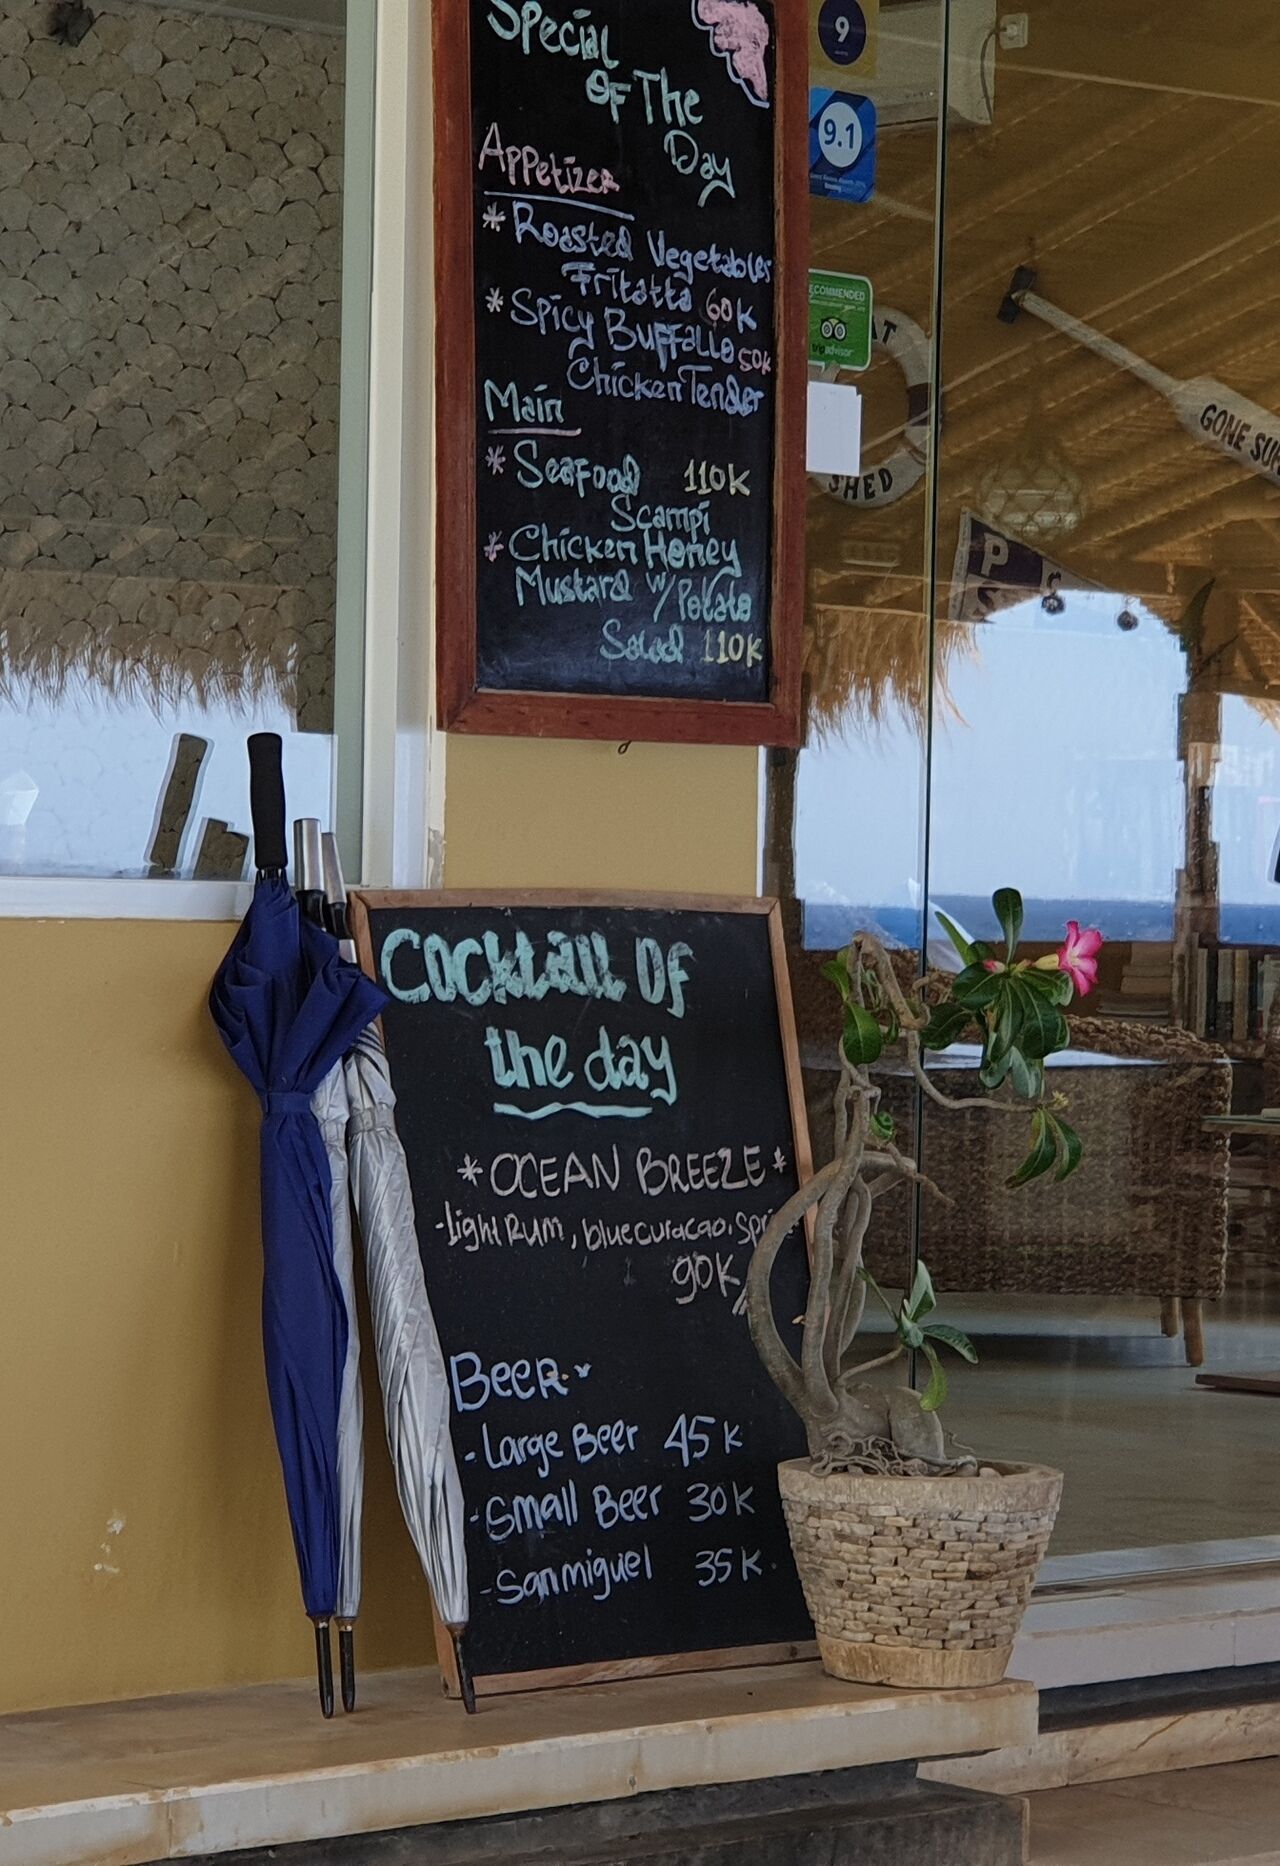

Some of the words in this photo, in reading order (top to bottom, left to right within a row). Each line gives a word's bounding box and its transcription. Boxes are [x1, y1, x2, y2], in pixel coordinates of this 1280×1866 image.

[487, 0, 619, 68] Special
[835, 15, 850, 42] 9
[633, 67, 703, 126] The
[823, 118, 854, 149] 9.1
[664, 129, 736, 207] Day
[513, 200, 634, 261] Roasted
[647, 230, 772, 285] Vegetables
[808, 283, 866, 302] ECOMMENDED
[510, 287, 595, 359] Spicy
[484, 378, 565, 423] Main
[567, 356, 682, 401] Chicken
[677, 364, 765, 417] Tender
[1200, 403, 1252, 451] GONE
[828, 467, 894, 500] SHED
[611, 494, 710, 535] Scampi
[509, 524, 639, 565] Chicken
[644, 529, 742, 595] Honey
[516, 564, 633, 607] Mustard
[484, 1025, 574, 1091] the
[584, 1025, 677, 1106] day
[489, 1144, 621, 1198] OCEAN
[636, 1145, 767, 1196] BREEZE
[572, 1419, 640, 1465] Beer
[593, 1481, 663, 1530] Beer
